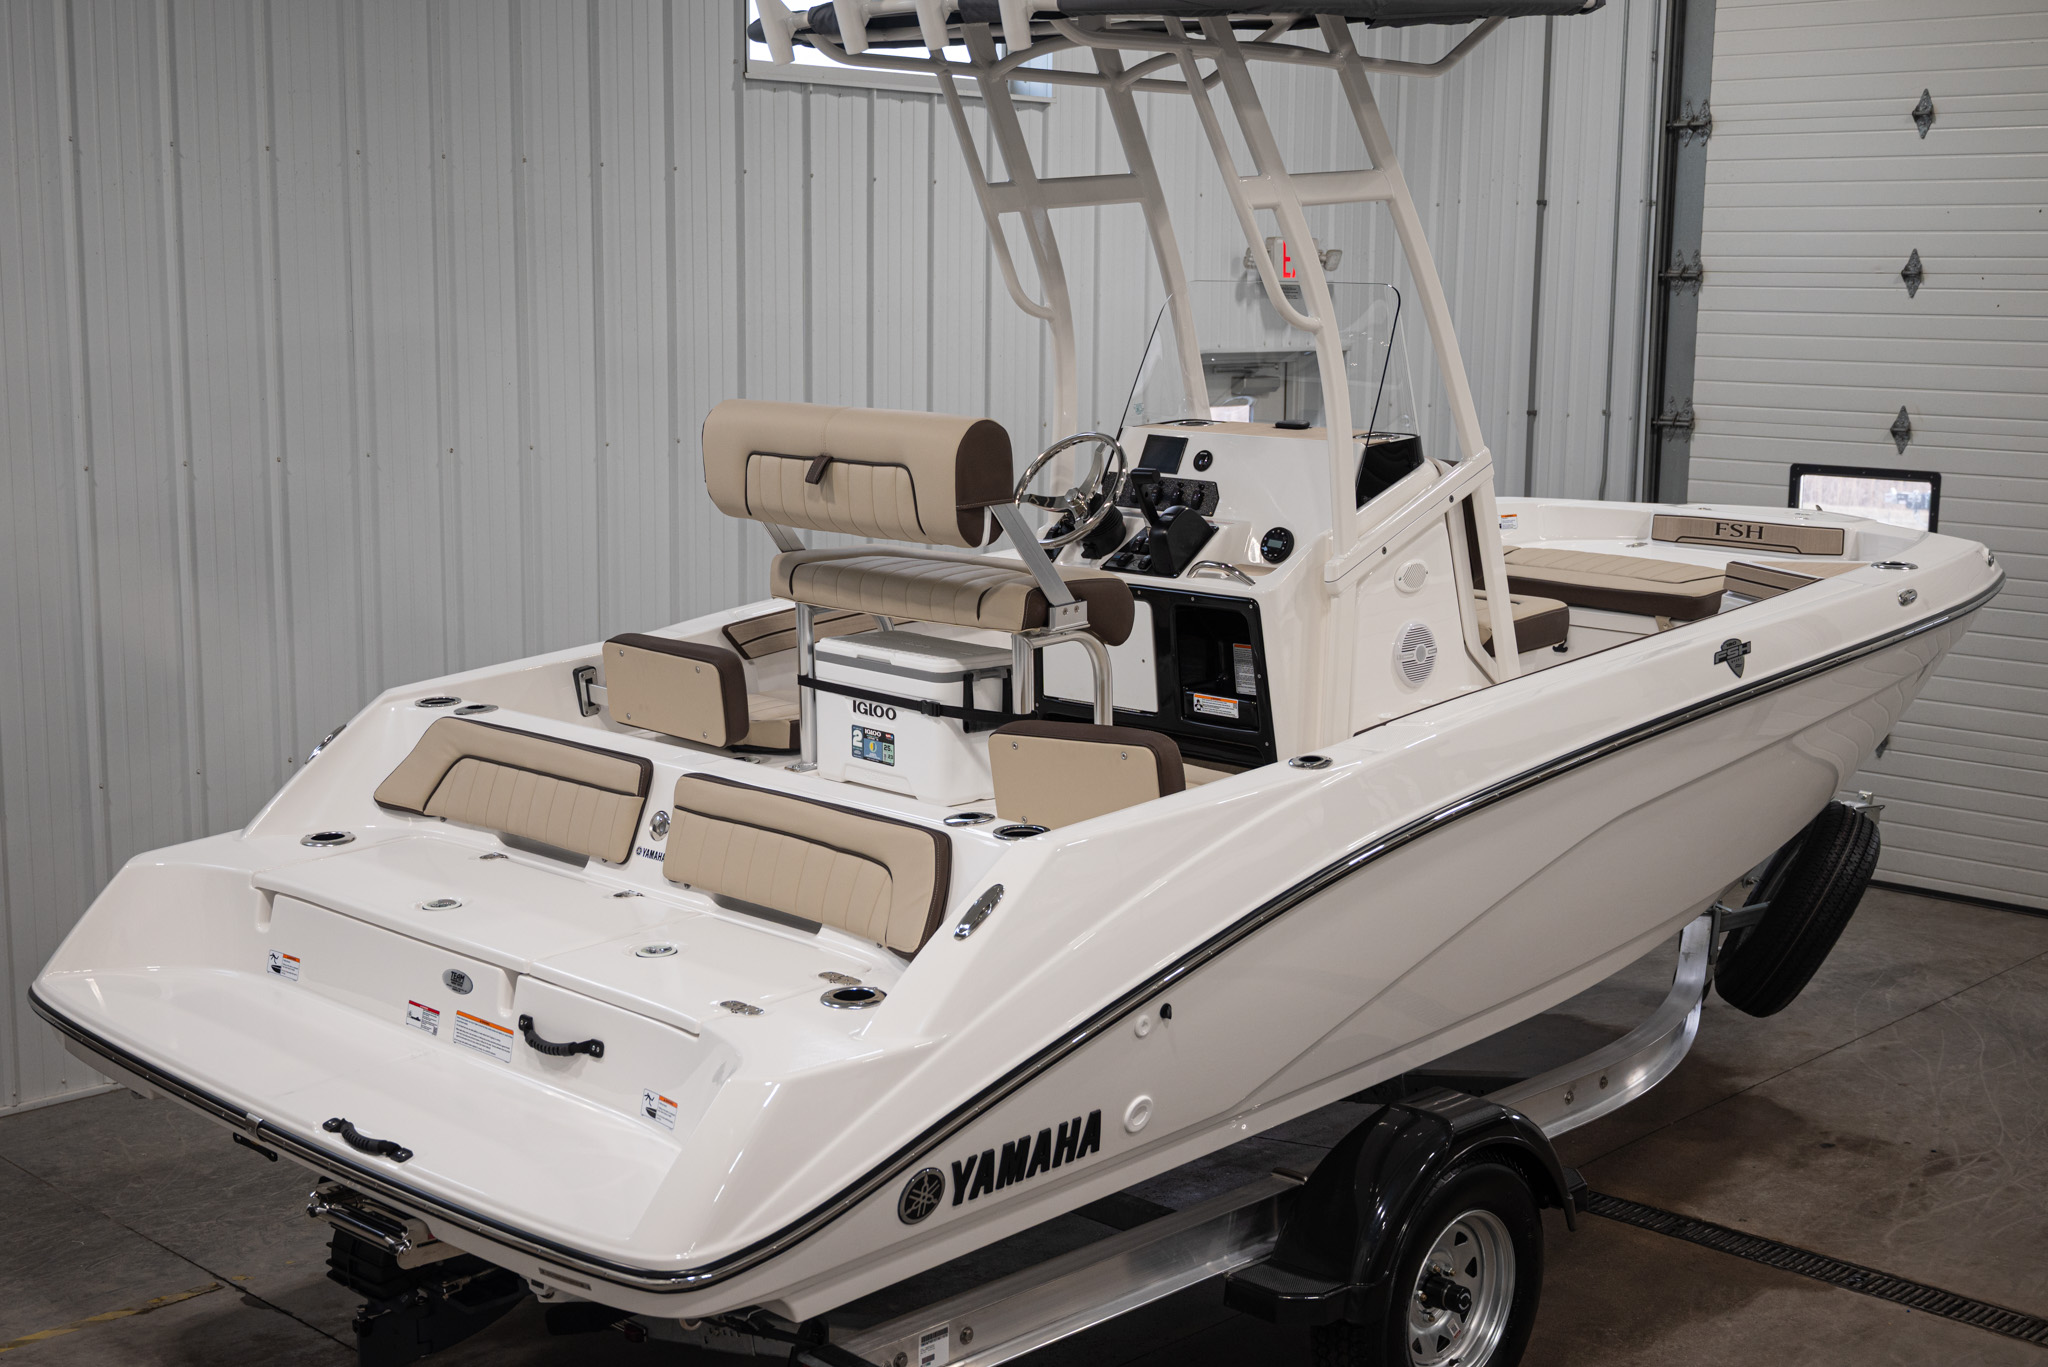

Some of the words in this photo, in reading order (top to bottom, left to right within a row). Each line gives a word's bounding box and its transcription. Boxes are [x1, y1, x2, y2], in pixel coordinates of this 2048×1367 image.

[1715, 522, 1764, 539] FSH
[1714, 641, 1751, 665] FSH
[853, 700, 897, 720] IGLOO
[853, 729, 863, 748] 2
[864, 728, 881, 737] IGLOO
[451, 971, 465, 980] TEAM
[952, 1109, 1102, 1207] YAMAHA
